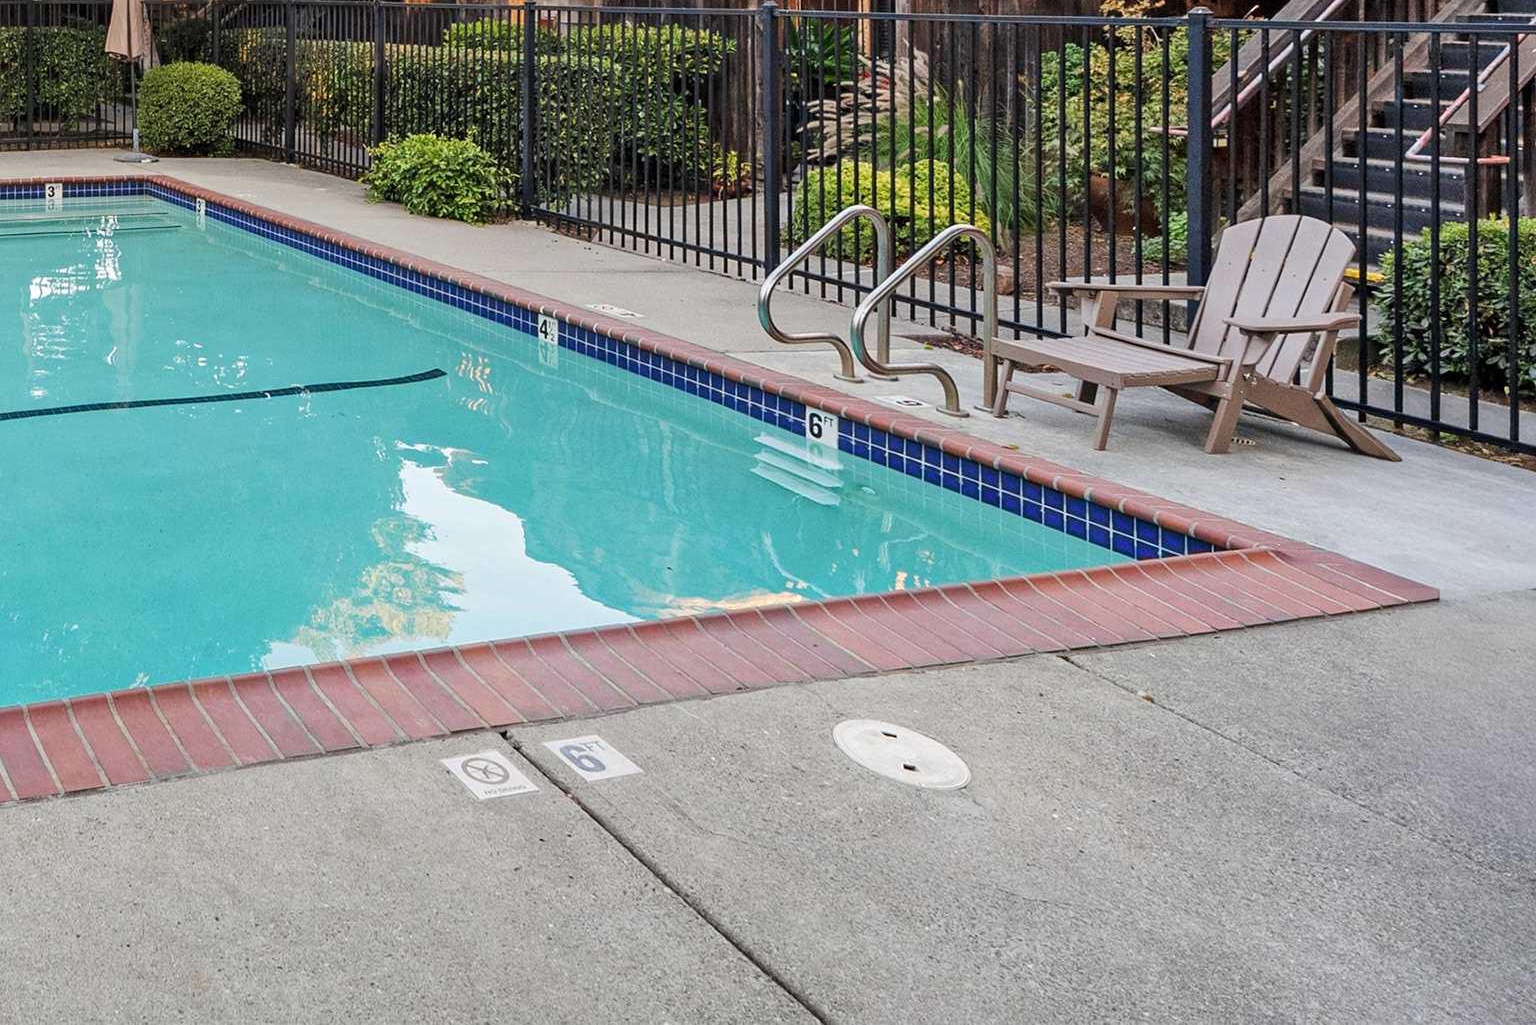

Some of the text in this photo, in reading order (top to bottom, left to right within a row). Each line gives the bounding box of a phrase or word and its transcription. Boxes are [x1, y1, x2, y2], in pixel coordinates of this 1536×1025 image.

[47, 186, 55, 198] 3
[540, 319, 549, 339] 4
[808, 412, 834, 439] 6 FT
[559, 744, 606, 773] 6
